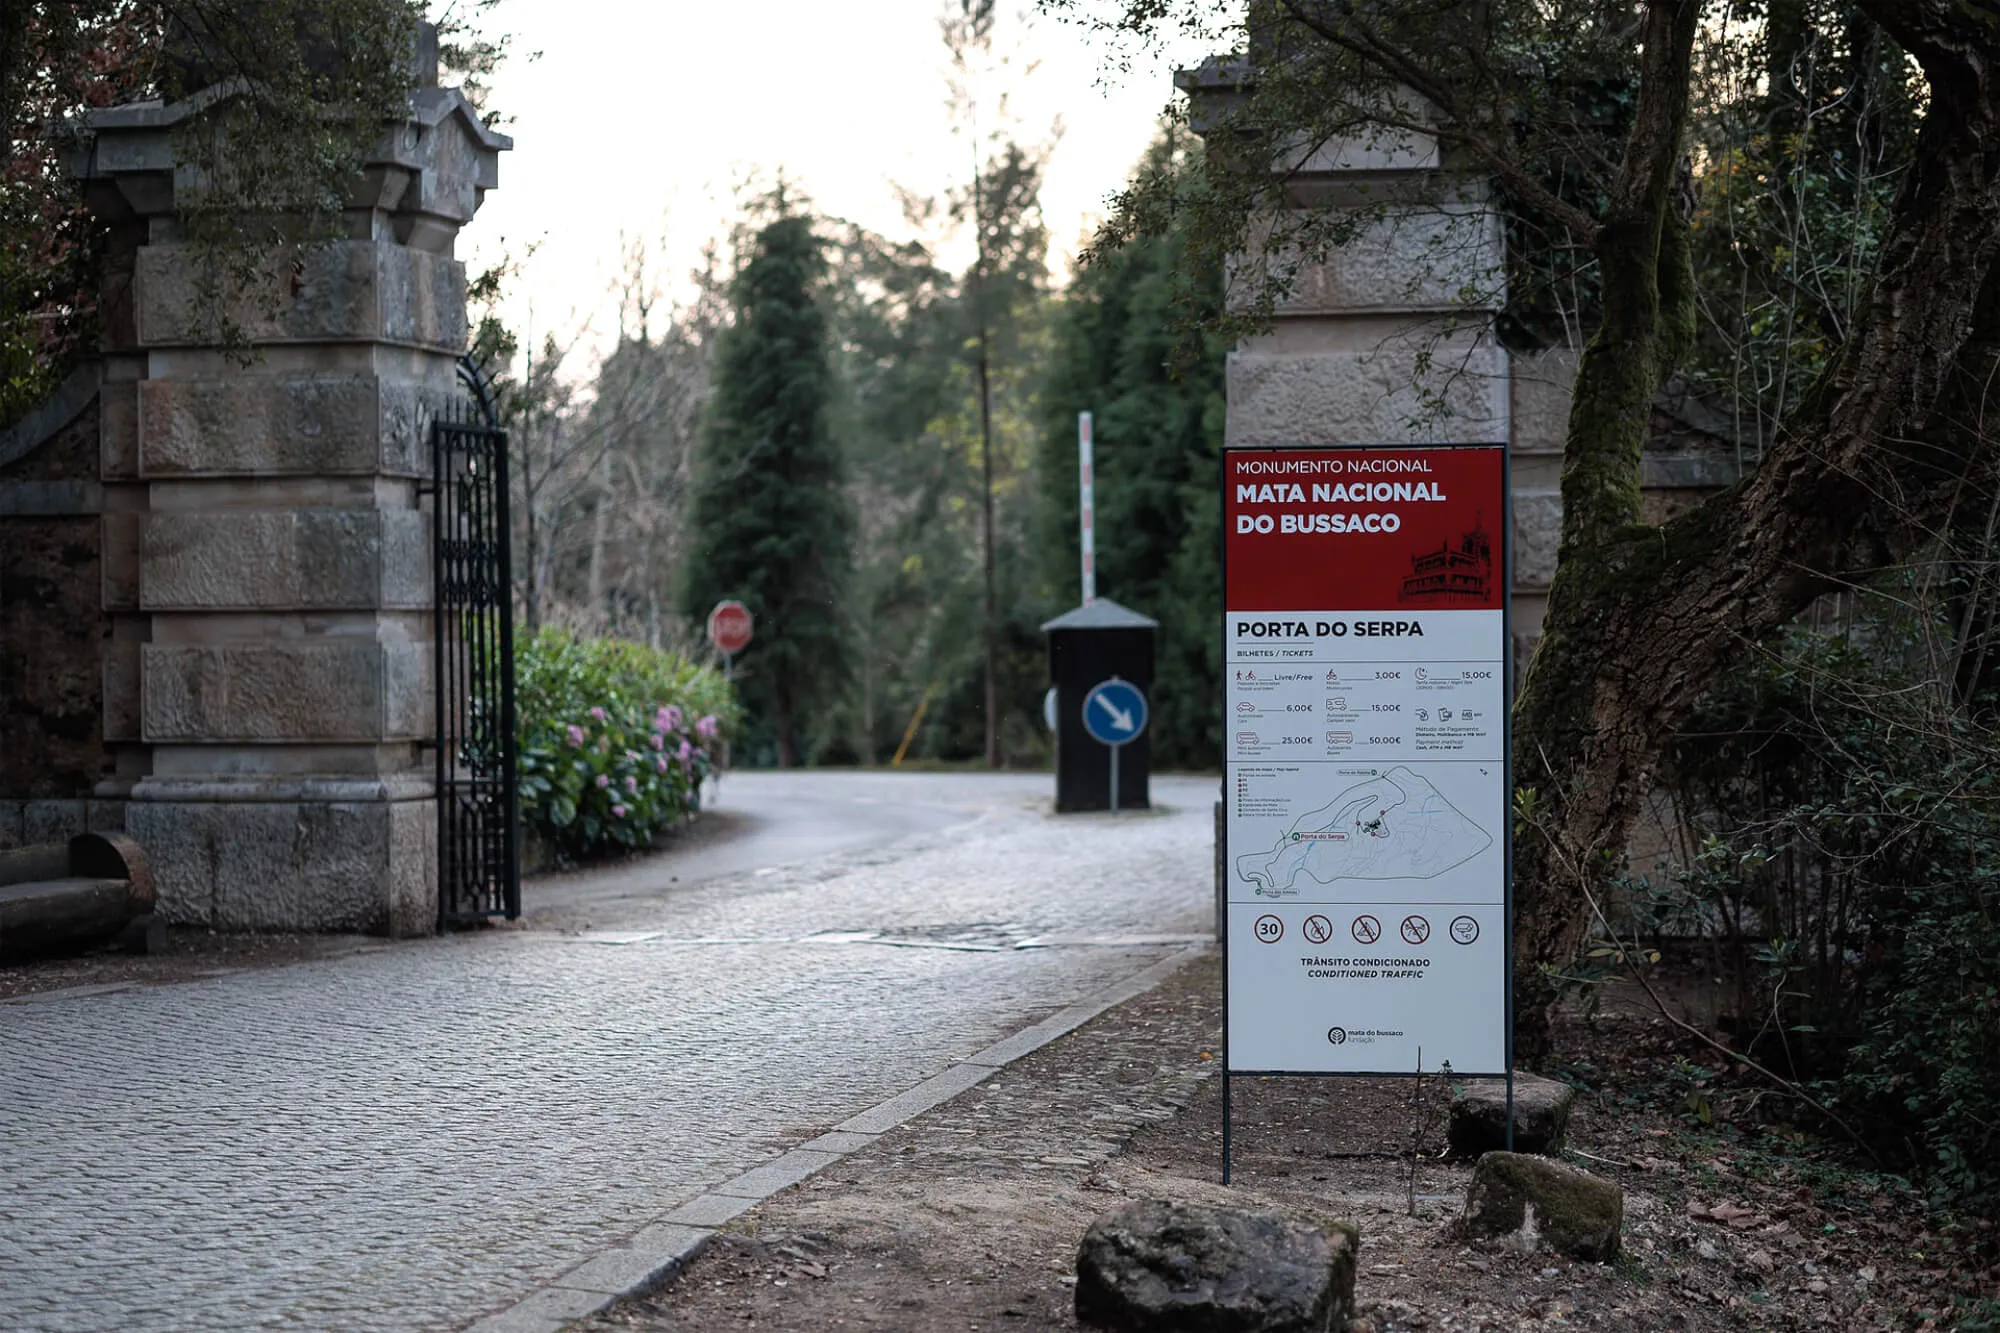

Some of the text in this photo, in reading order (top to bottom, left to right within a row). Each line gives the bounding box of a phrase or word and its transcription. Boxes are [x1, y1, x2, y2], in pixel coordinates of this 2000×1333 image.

[1236, 459, 1432, 474] MONUMENTO NACIONAL
[1236, 482, 1446, 504] MATA NACIONAL
[1236, 513, 1401, 534] DO BUSSACO
[1237, 621, 1424, 637] PORTA DO SERPA
[1282, 649, 1314, 657] TICKETS
[1375, 671, 1401, 680] 3,00€
[1286, 704, 1313, 713] 6,00€
[1371, 704, 1401, 713] 15,00€
[1281, 736, 1313, 745] 25,00€
[1369, 736, 1401, 745] 50,00€
[1260, 923, 1278, 935] 30
[1301, 956, 1430, 967] TRÂNSITO CONDICIONADO
[1308, 969, 1424, 979] CONDITIONED TRAFFIC
